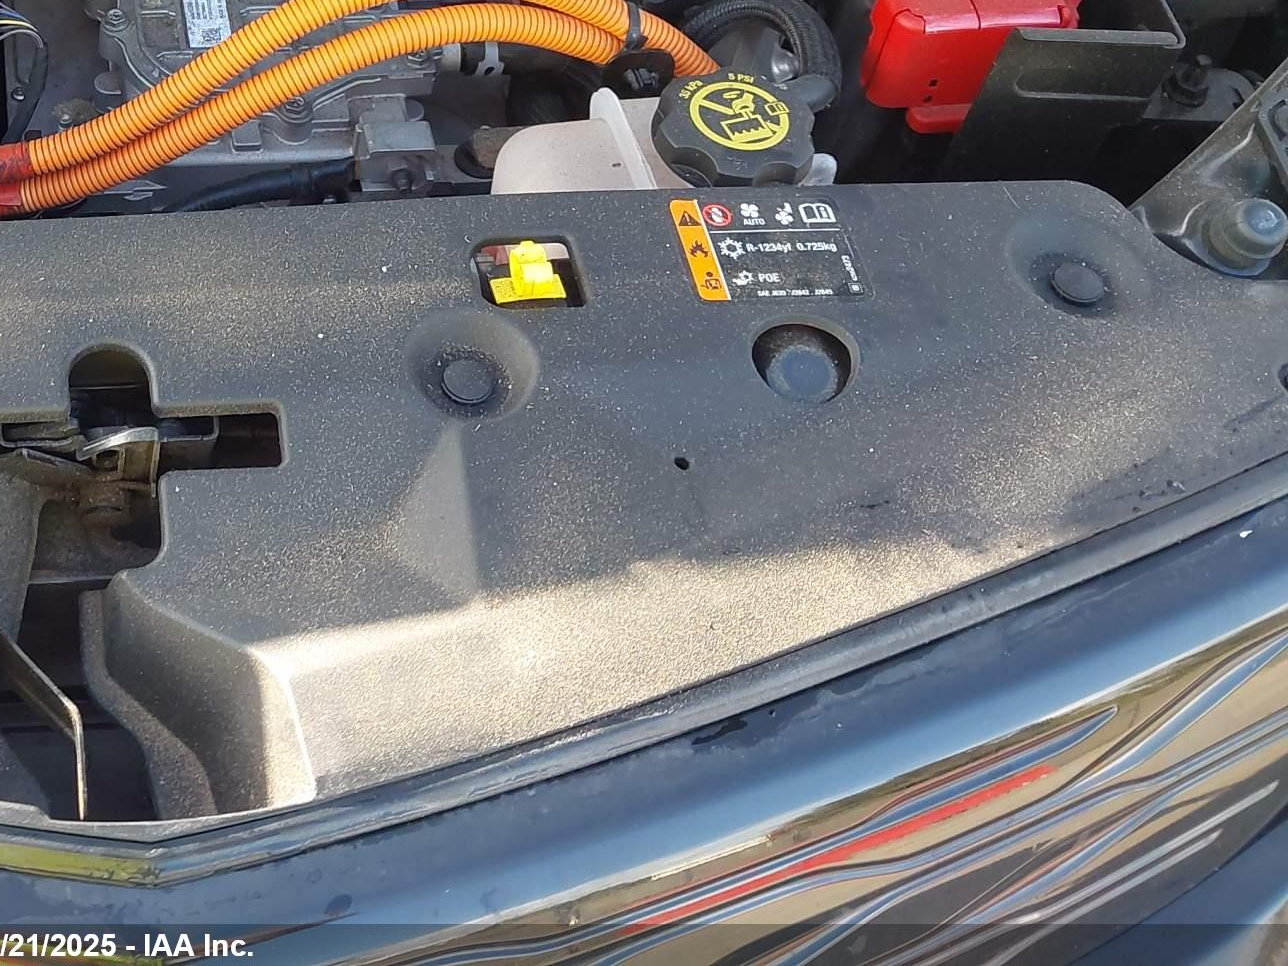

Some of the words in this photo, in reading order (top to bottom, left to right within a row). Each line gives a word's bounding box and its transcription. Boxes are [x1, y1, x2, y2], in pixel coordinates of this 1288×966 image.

[727, 72, 736, 81] 5
[737, 74, 755, 84] PSI
[679, 87, 691, 100] 35
[686, 79, 703, 93] kPa
[743, 217, 766, 226] AUTO
[746, 241, 792, 253] R-1234yf
[796, 241, 838, 253] 0.725kg
[758, 272, 781, 283] POE
